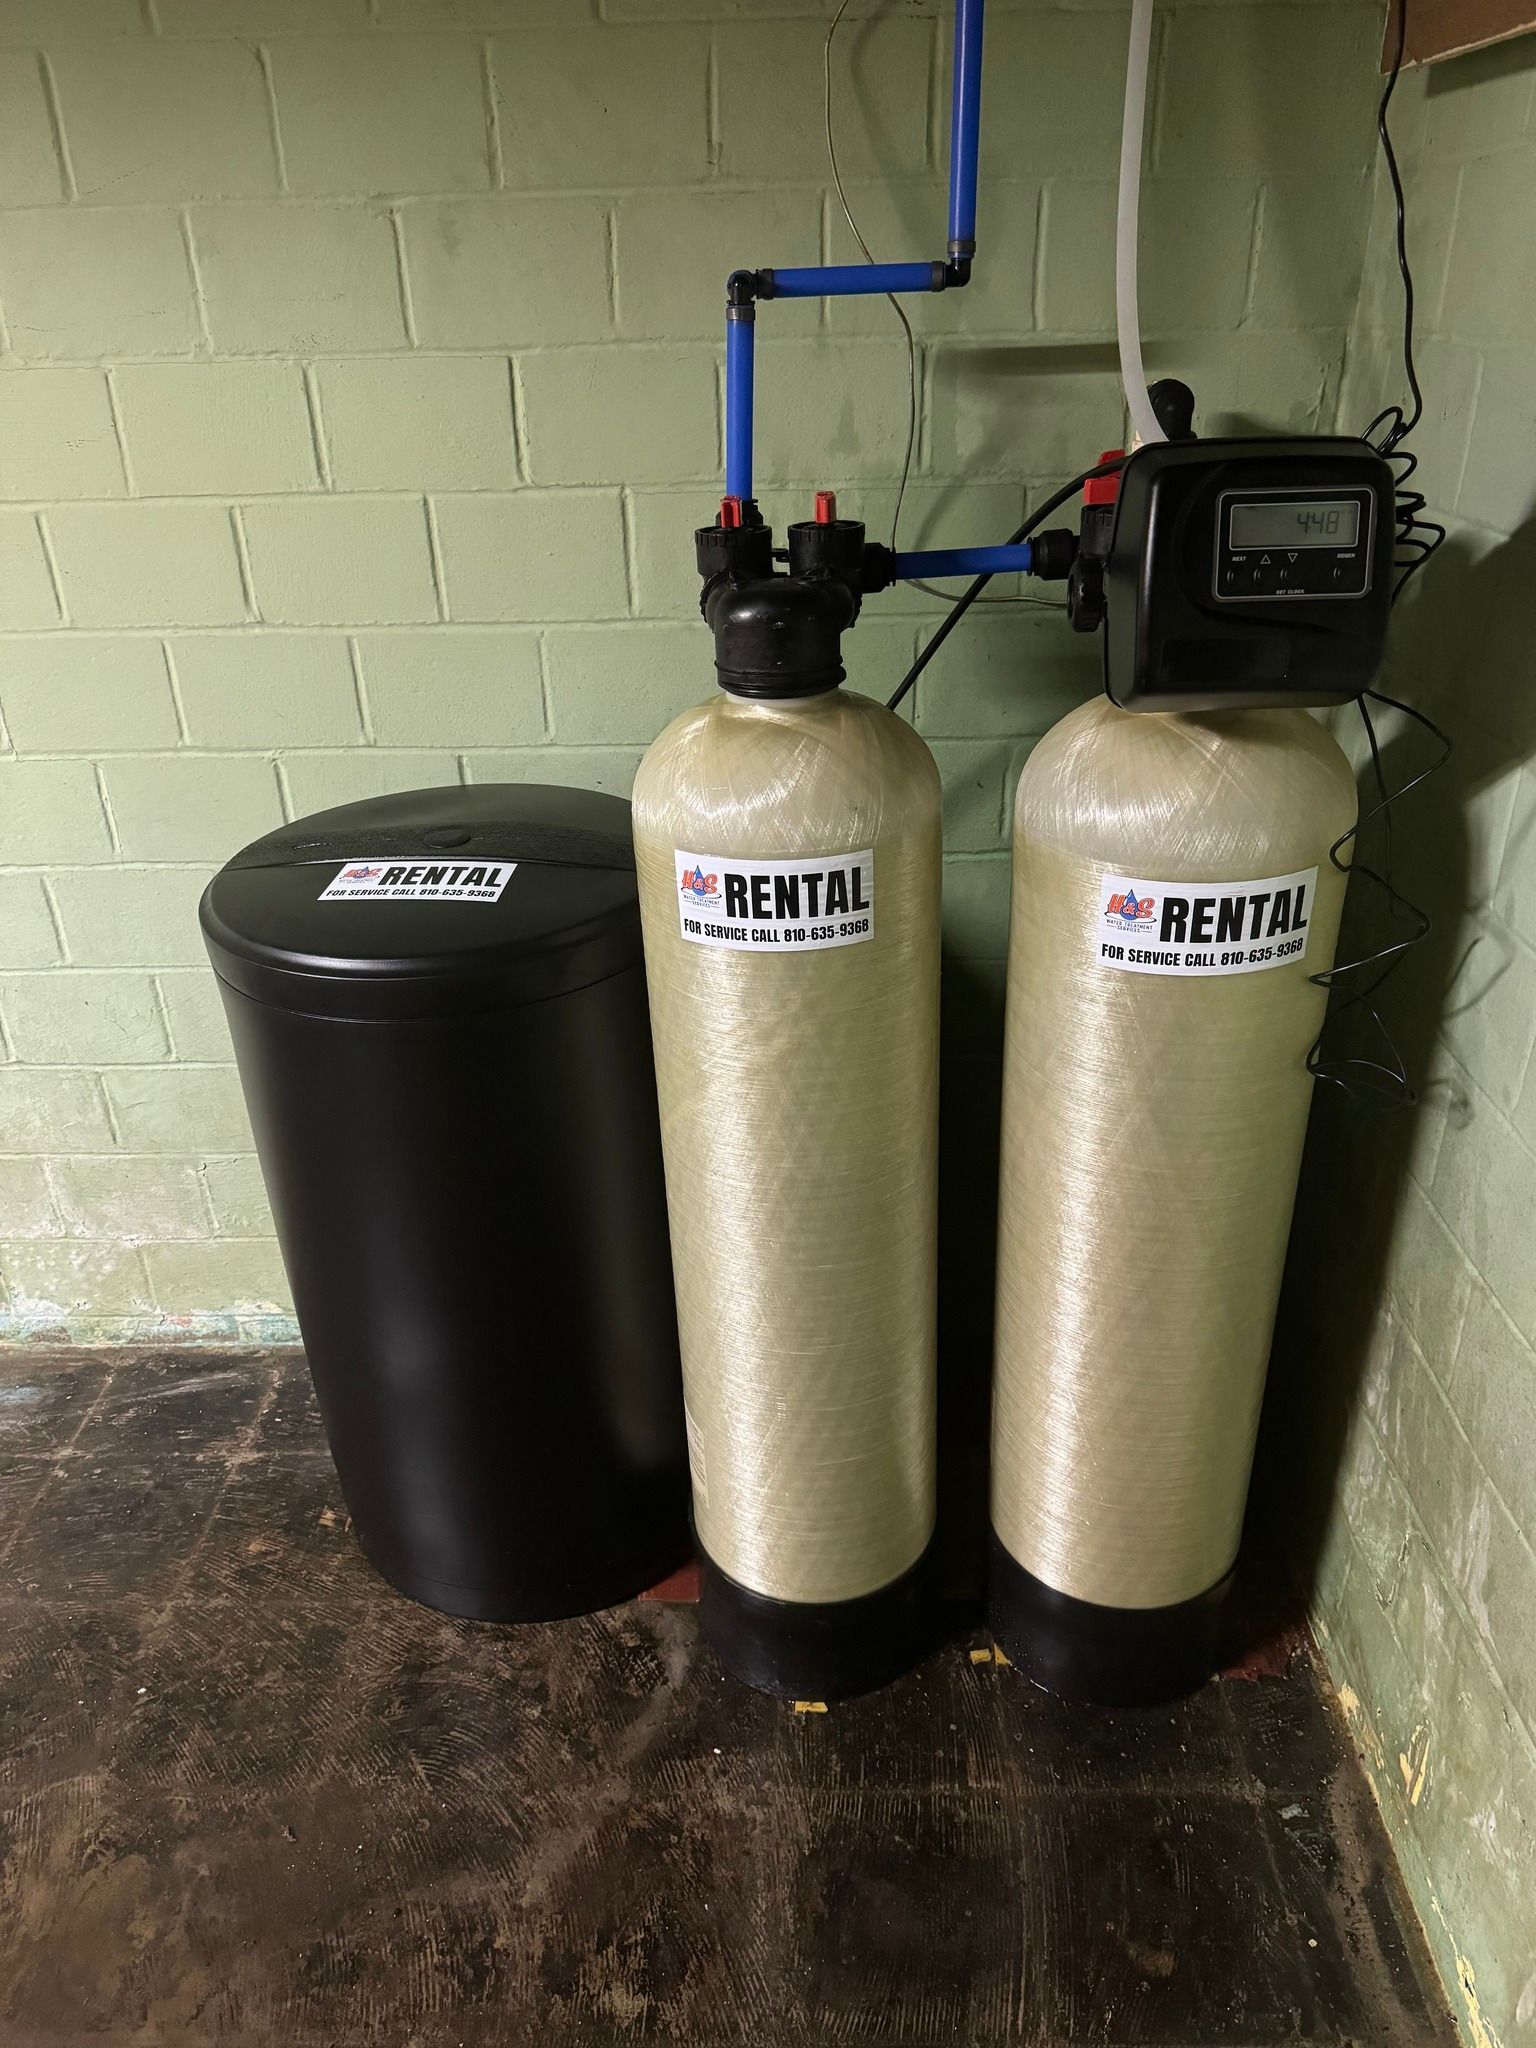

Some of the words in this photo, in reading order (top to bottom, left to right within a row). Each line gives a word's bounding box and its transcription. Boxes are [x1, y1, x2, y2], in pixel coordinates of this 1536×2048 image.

[377, 866, 503, 888] RENTAL
[682, 869, 718, 895] H&S
[326, 889, 347, 897] FOR
[348, 888, 391, 896] SERVICE
[391, 888, 416, 896] CALL
[419, 888, 496, 898] 810-635-9368
[724, 866, 870, 920] RENTAL
[1107, 893, 1156, 918] H&S
[1159, 884, 1308, 944] RENTAL
[683, 918, 702, 934] FOR
[704, 924, 748, 941] SERVICE
[751, 928, 781, 943] CALL
[783, 918, 870, 942] 810-635-9368
[1101, 943, 1125, 960] FOR
[1127, 947, 1181, 966] SERVICE
[1184, 951, 1217, 967] CALL
[1220, 937, 1304, 965] 810-635-9368
